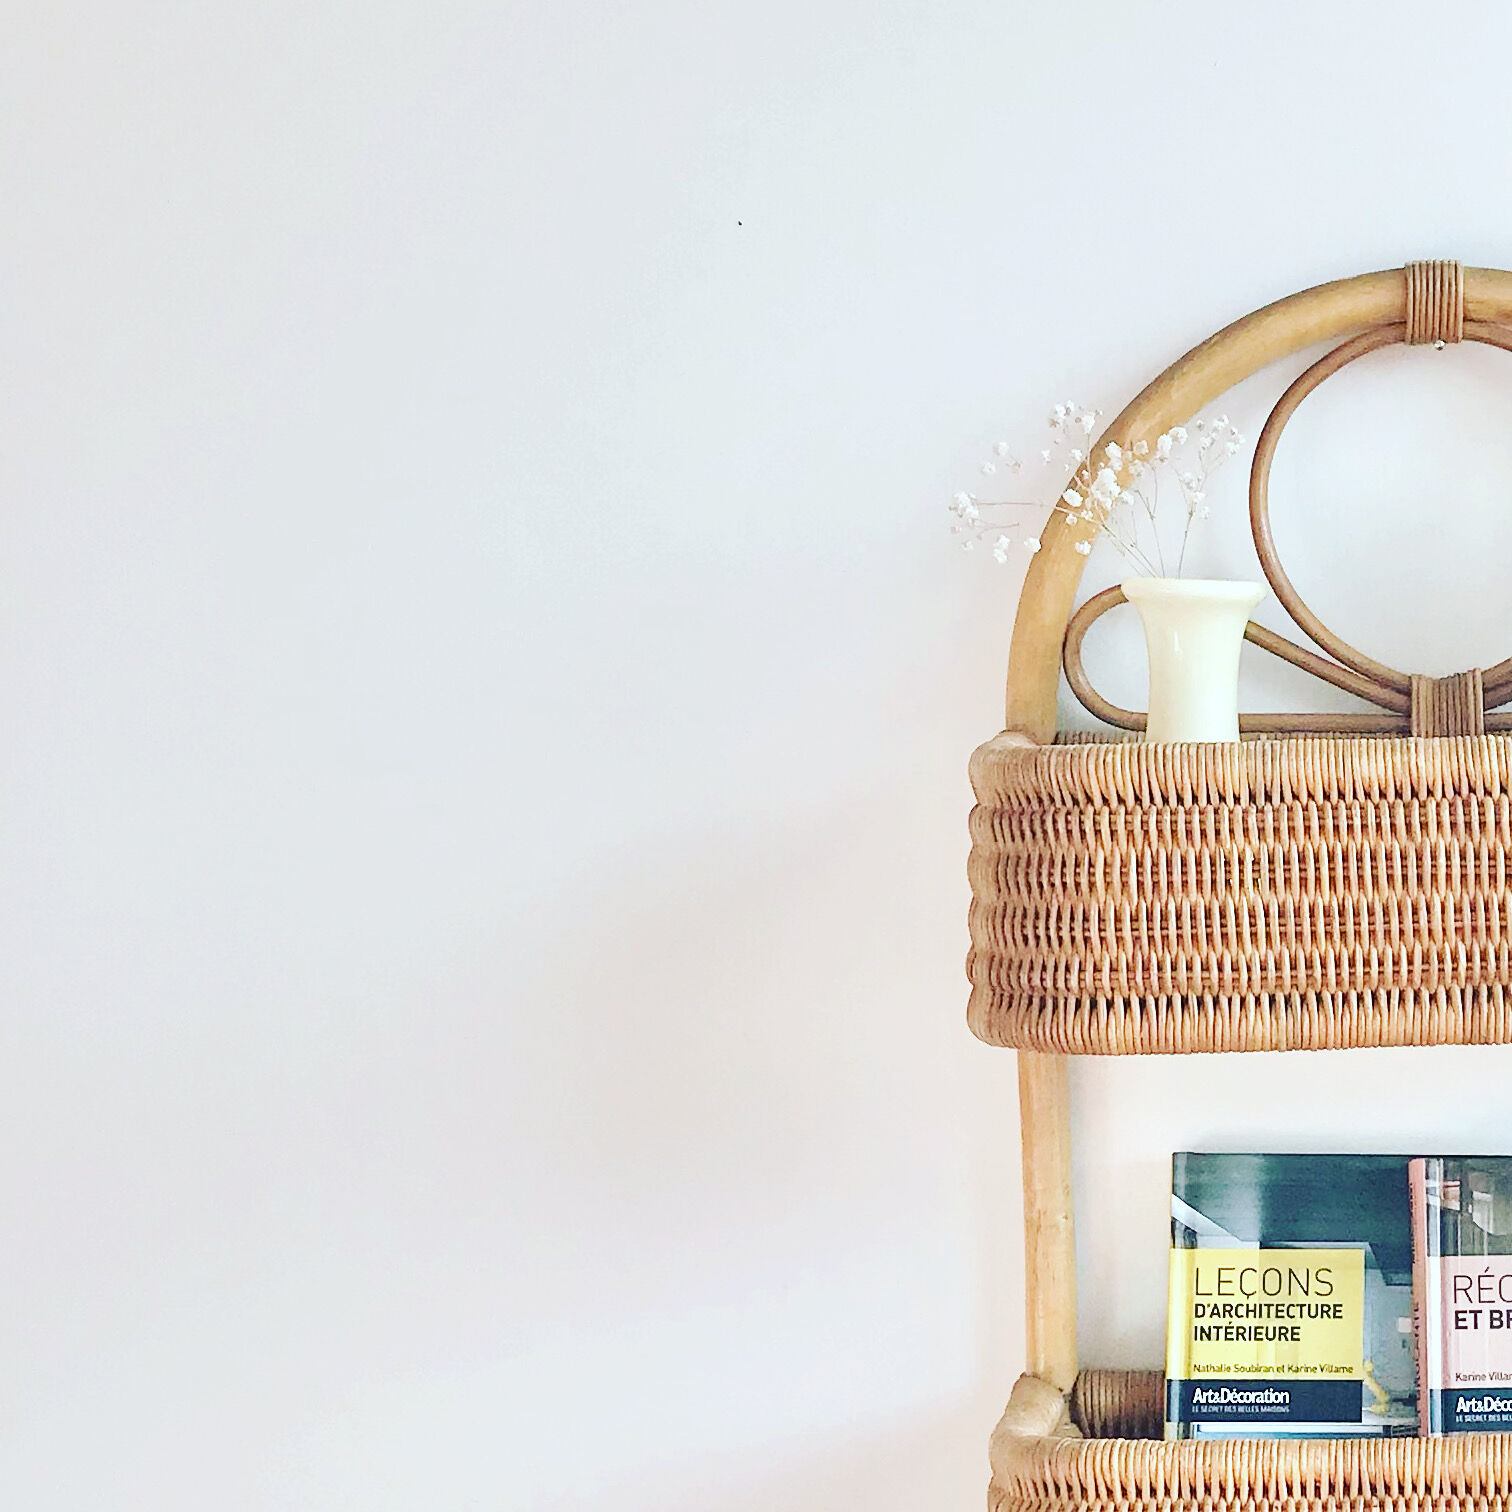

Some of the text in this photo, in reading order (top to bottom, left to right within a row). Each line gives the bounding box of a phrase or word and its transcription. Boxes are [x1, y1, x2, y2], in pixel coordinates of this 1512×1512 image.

[1195, 1267, 1334, 1300] LEÇONS
[1194, 1303, 1343, 1319] D'ARCHITECTURE
[1454, 1309, 1483, 1330] ET
[1194, 1321, 1301, 1341] INTÉRIEURE
[1193, 1363, 1231, 1374] Nathalie
[1233, 1363, 1275, 1374] Soubiran
[1276, 1364, 1285, 1374] et
[1287, 1363, 1318, 1374] Karine
[1455, 1372, 1487, 1382] Karine
[1192, 1387, 1290, 1404] Art&Décoration
